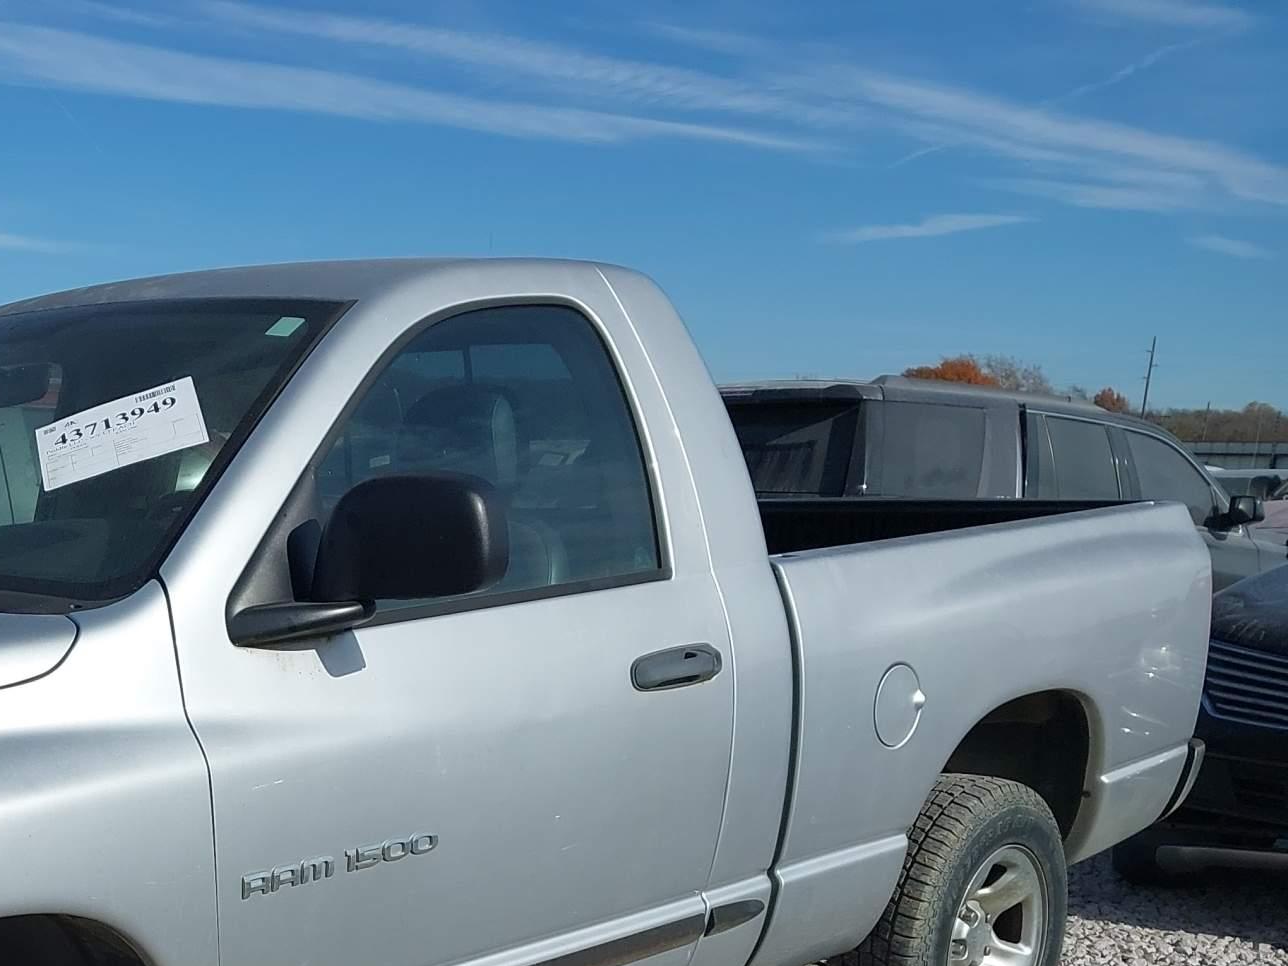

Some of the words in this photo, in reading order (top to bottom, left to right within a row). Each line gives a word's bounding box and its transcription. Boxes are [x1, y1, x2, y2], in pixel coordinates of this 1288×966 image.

[54, 396, 177, 446] 43713949
[240, 854, 336, 900] RAM
[343, 832, 439, 873] 1500
